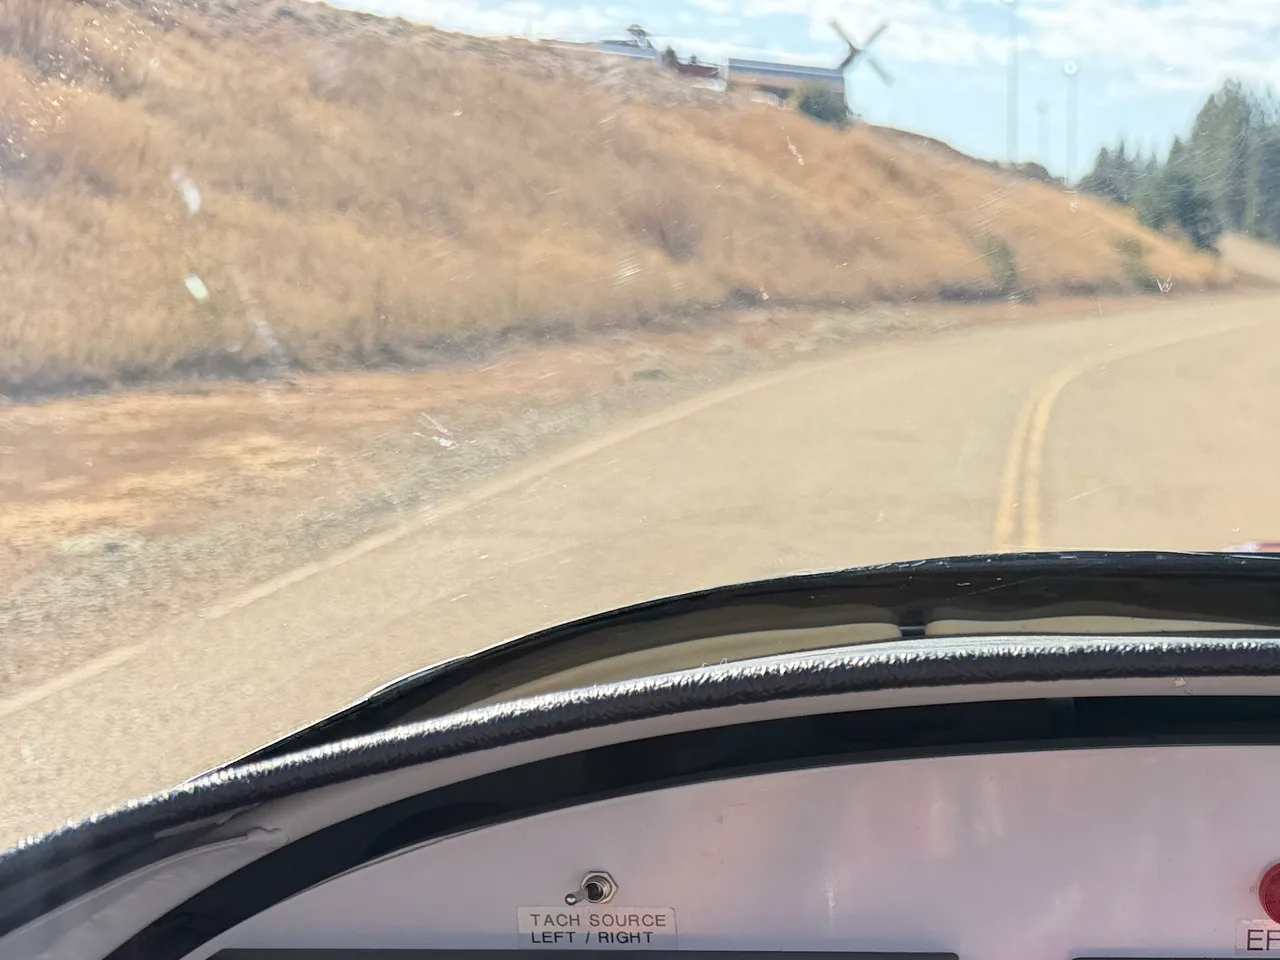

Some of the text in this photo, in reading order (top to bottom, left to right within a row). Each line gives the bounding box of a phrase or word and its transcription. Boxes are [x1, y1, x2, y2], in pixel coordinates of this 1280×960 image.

[530, 914, 666, 926] TACH SOURCE
[531, 932, 576, 944] LEFT
[599, 932, 653, 944] RIGHT
